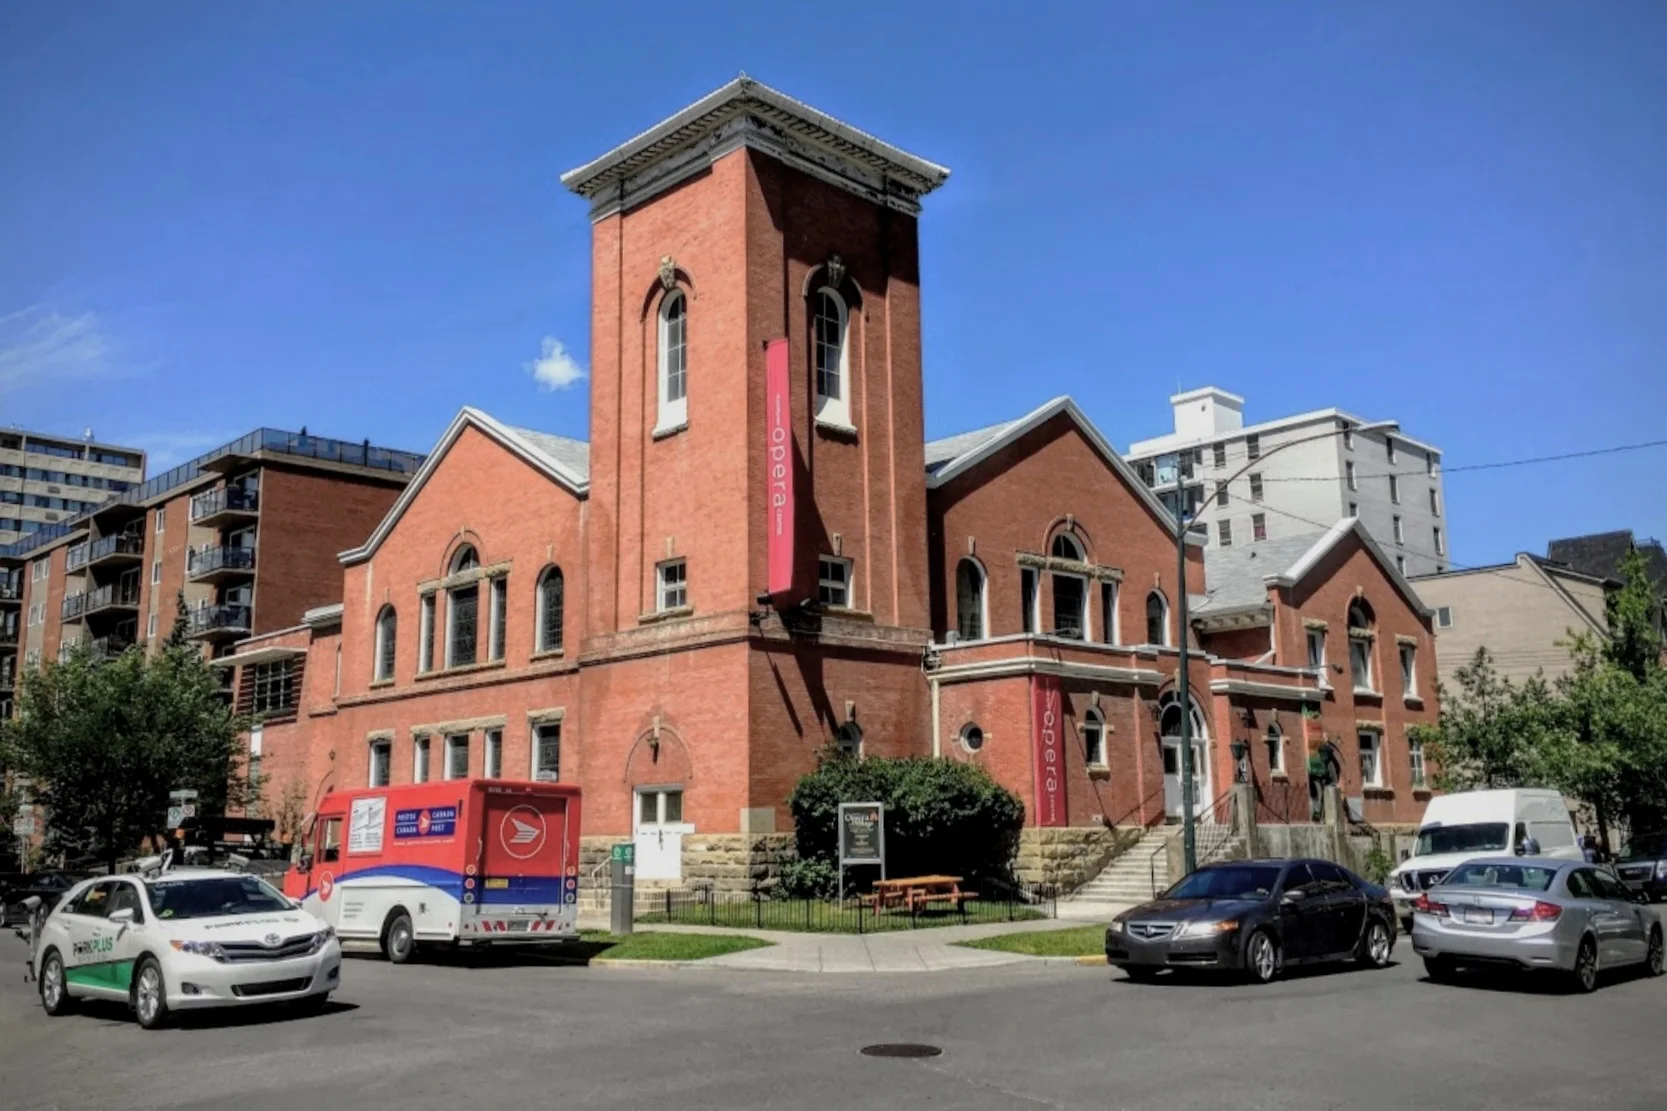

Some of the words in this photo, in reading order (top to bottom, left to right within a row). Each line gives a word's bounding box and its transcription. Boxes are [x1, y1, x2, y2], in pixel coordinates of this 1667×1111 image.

[770, 427, 786, 507] opera
[1042, 710, 1057, 792] opera
[397, 825, 417, 834] CANADA
[431, 824, 445, 832] POST
[432, 810, 454, 819] CANADA
